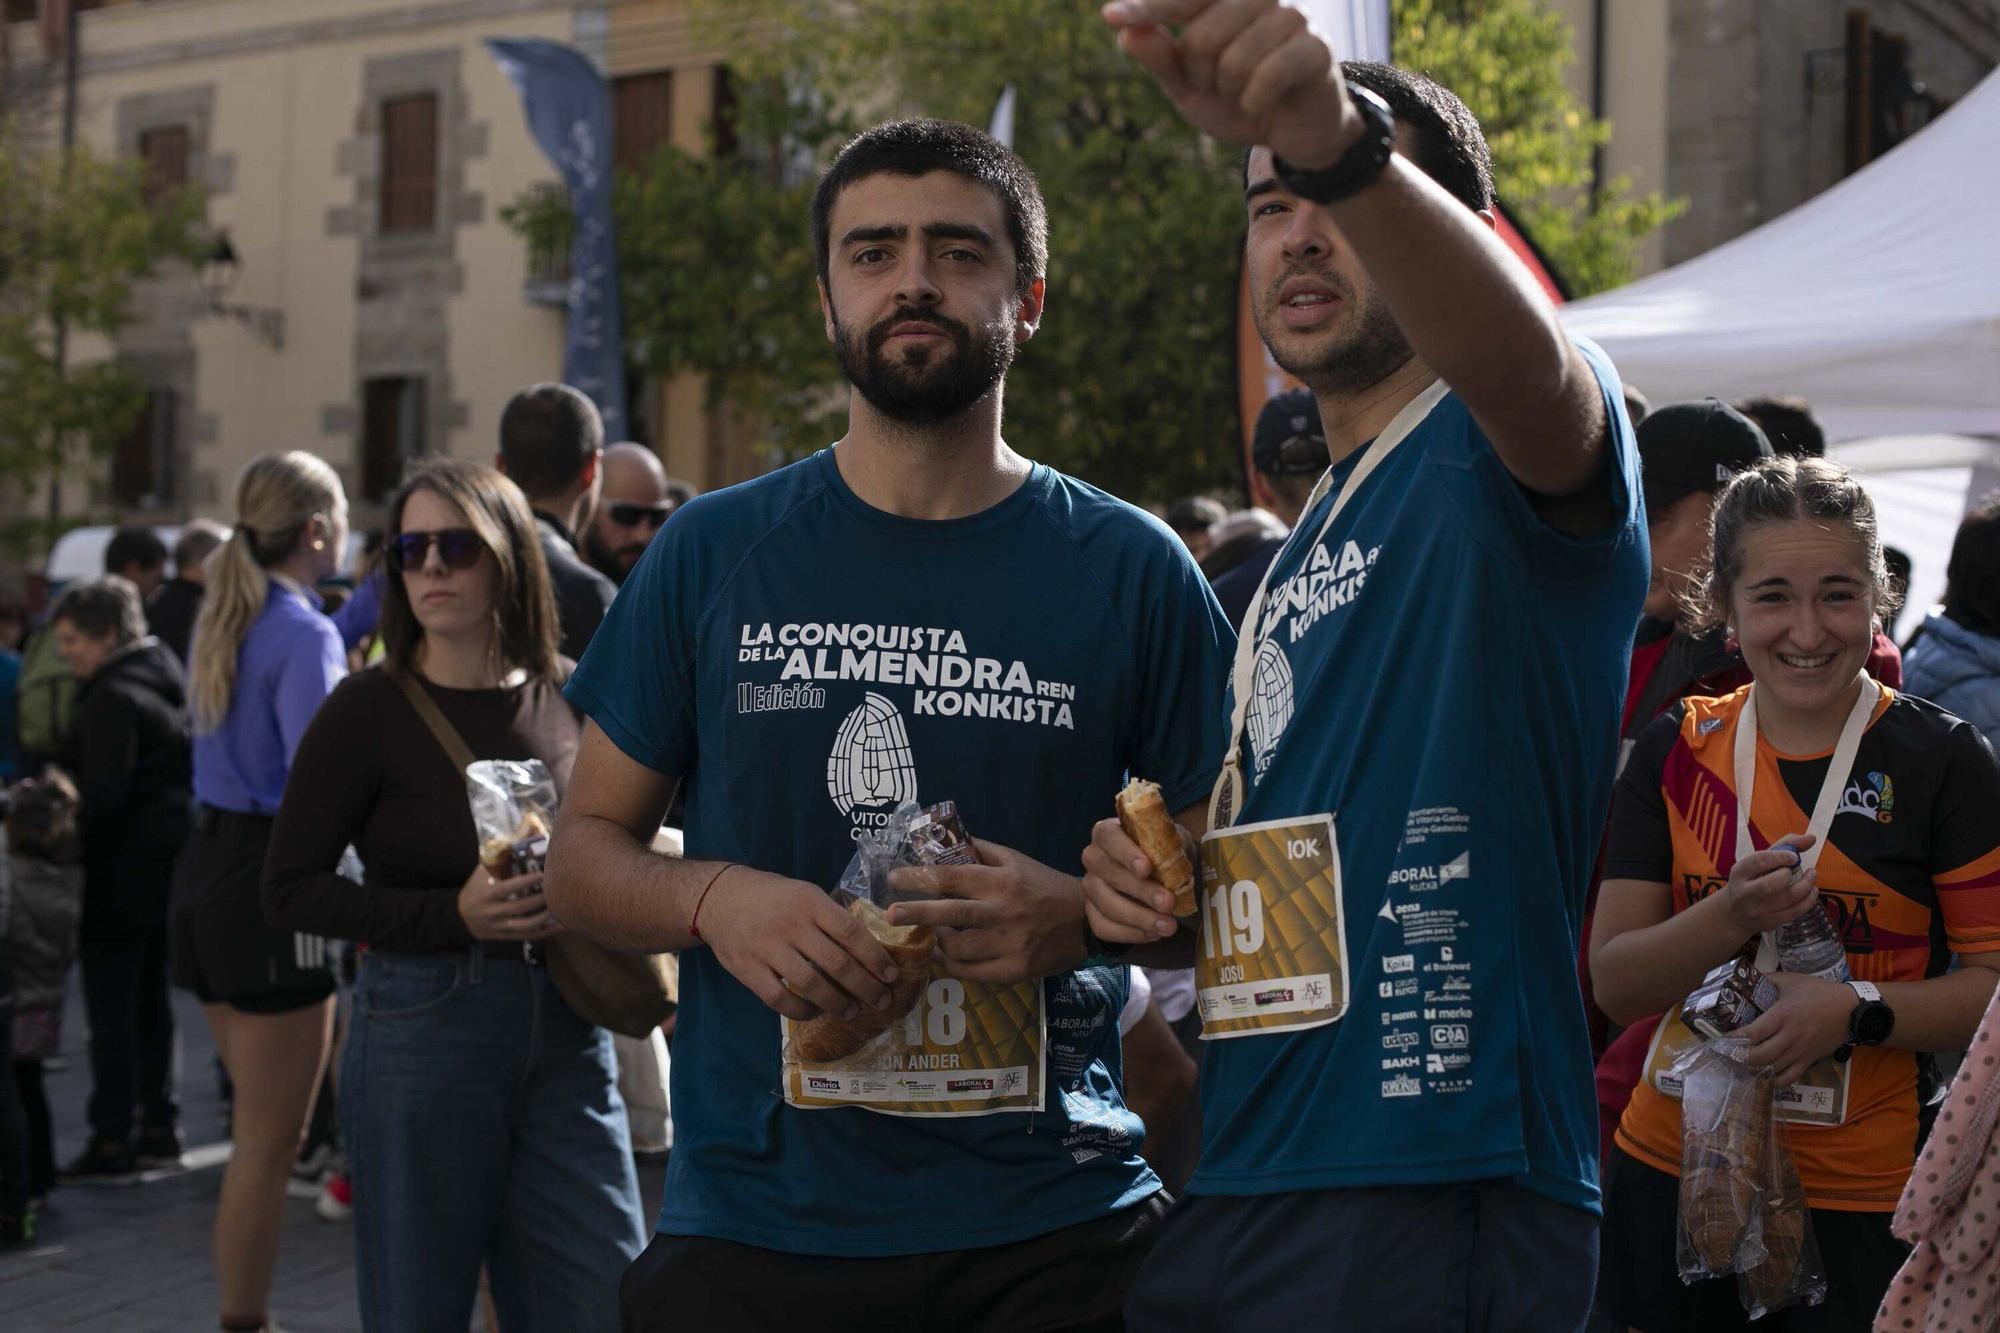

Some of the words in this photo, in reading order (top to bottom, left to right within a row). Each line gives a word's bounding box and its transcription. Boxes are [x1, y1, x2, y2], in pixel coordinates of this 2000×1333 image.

[1290, 571, 1367, 643] KONKIS
[740, 623, 774, 646] LA
[778, 622, 967, 655] CONQUISTA
[738, 648, 761, 662] DE
[764, 647, 785, 661] LA
[780, 648, 1034, 694] ALMENDRA
[1036, 680, 1076, 701] REN
[753, 682, 826, 712] Edición
[913, 690, 1075, 730] KONKISTA
[1287, 838, 1320, 860] 10K
[1202, 879, 1264, 960] 119
[1219, 965, 1245, 984] JOSU
[908, 1053, 960, 1070] ANDER
[812, 1079, 837, 1089] Diario
